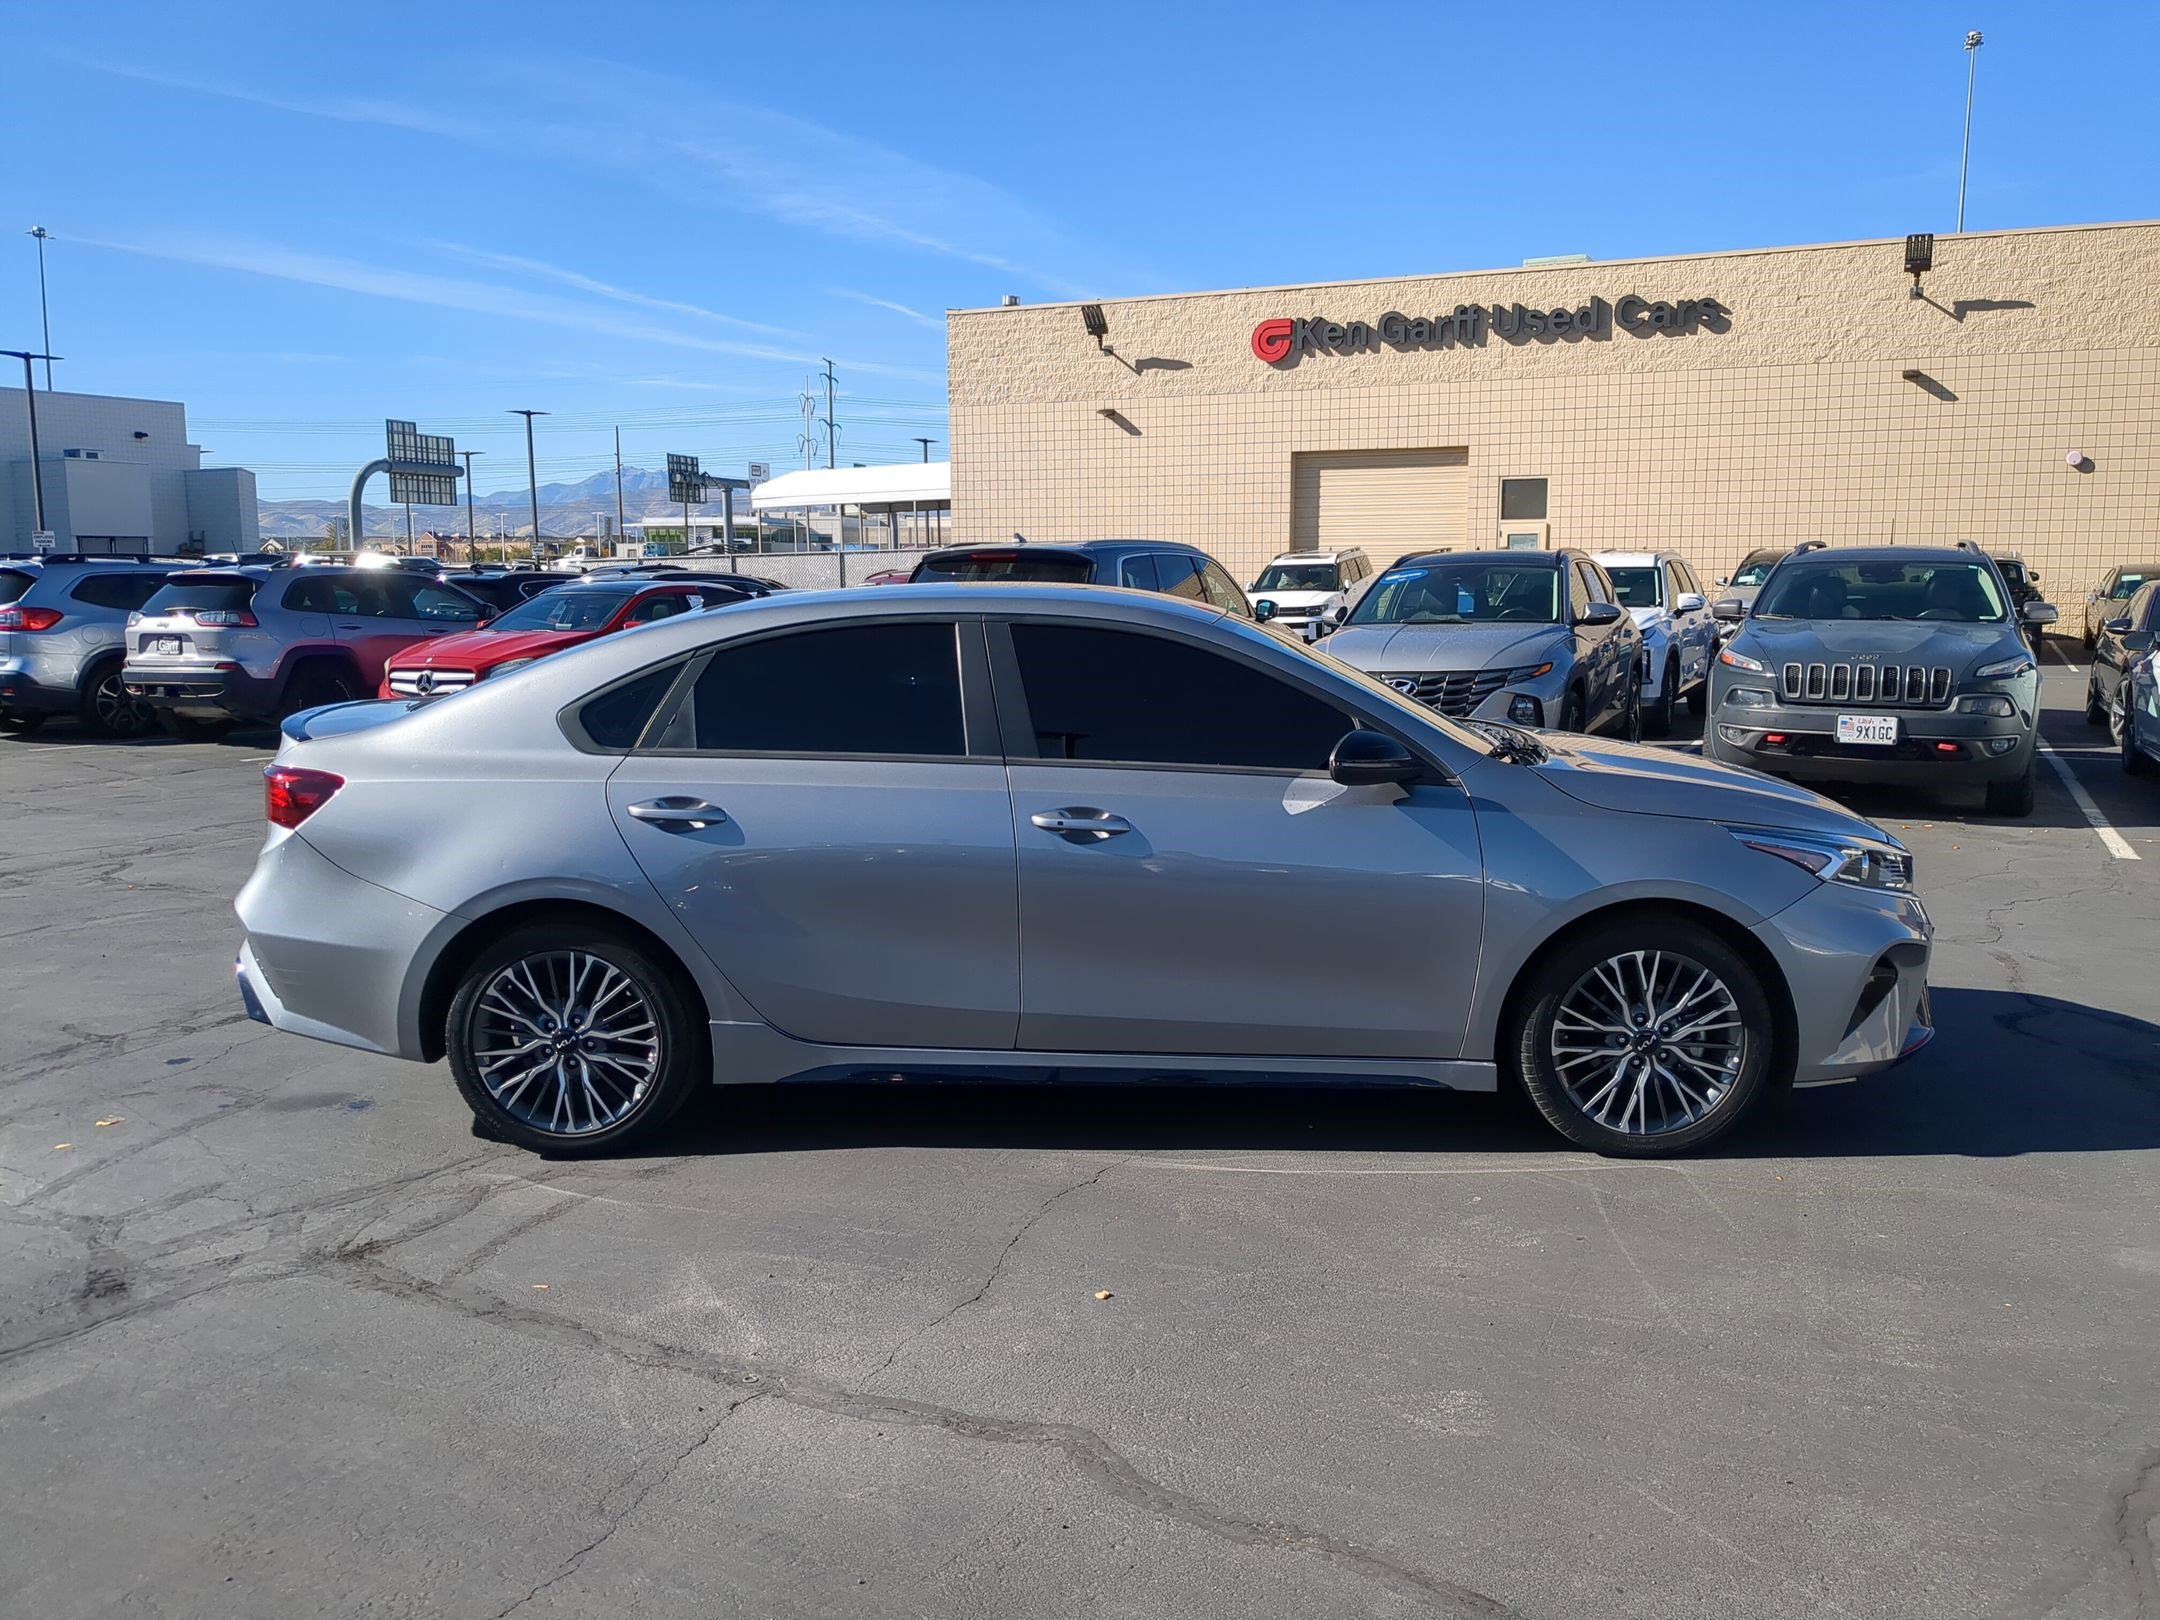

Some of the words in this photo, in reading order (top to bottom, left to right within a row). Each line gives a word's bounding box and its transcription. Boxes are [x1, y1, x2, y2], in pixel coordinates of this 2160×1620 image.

[1295, 317, 1369, 350] Ken
[1377, 303, 1479, 345] Garff
[1492, 295, 1600, 338] Used
[1614, 294, 1719, 331] Cars
[1856, 725, 1893, 740] 9X1GC
